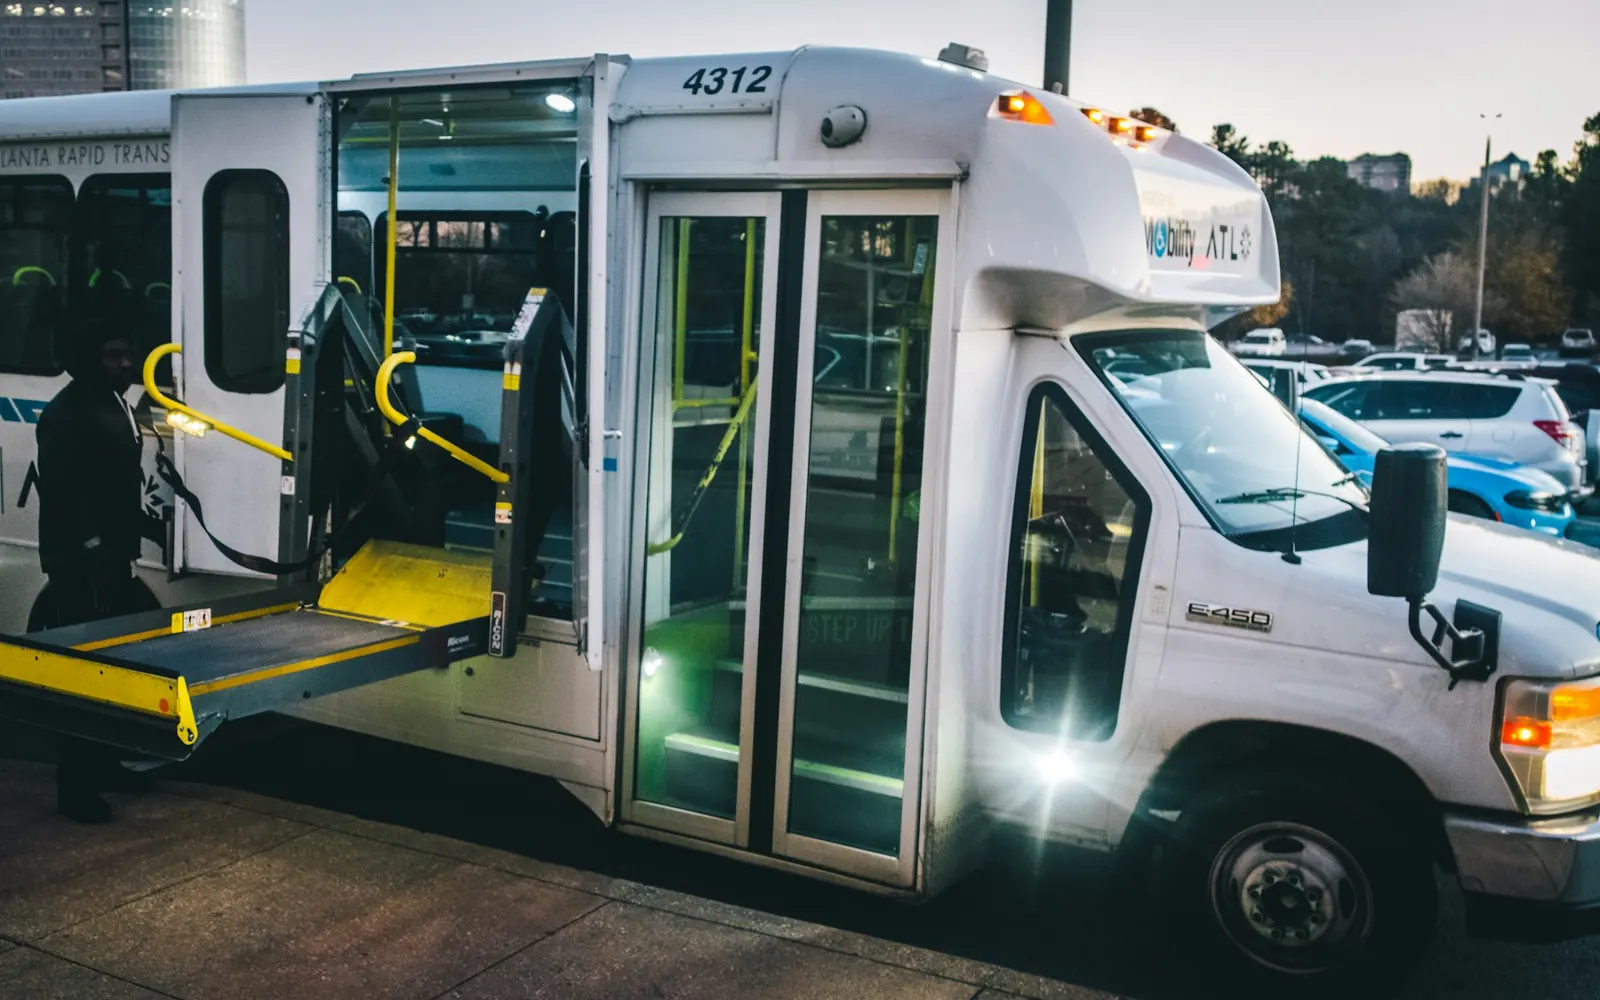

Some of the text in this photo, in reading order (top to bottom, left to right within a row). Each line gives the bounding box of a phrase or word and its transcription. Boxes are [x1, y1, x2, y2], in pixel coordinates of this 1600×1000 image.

[682, 65, 772, 95] 4312
[0, 143, 170, 168] LANTA RAPID TRANS
[1206, 223, 1238, 260] ATL
[808, 612, 892, 643] STEP UP
[1188, 602, 1270, 625] E-450
[492, 610, 502, 650] RICON
